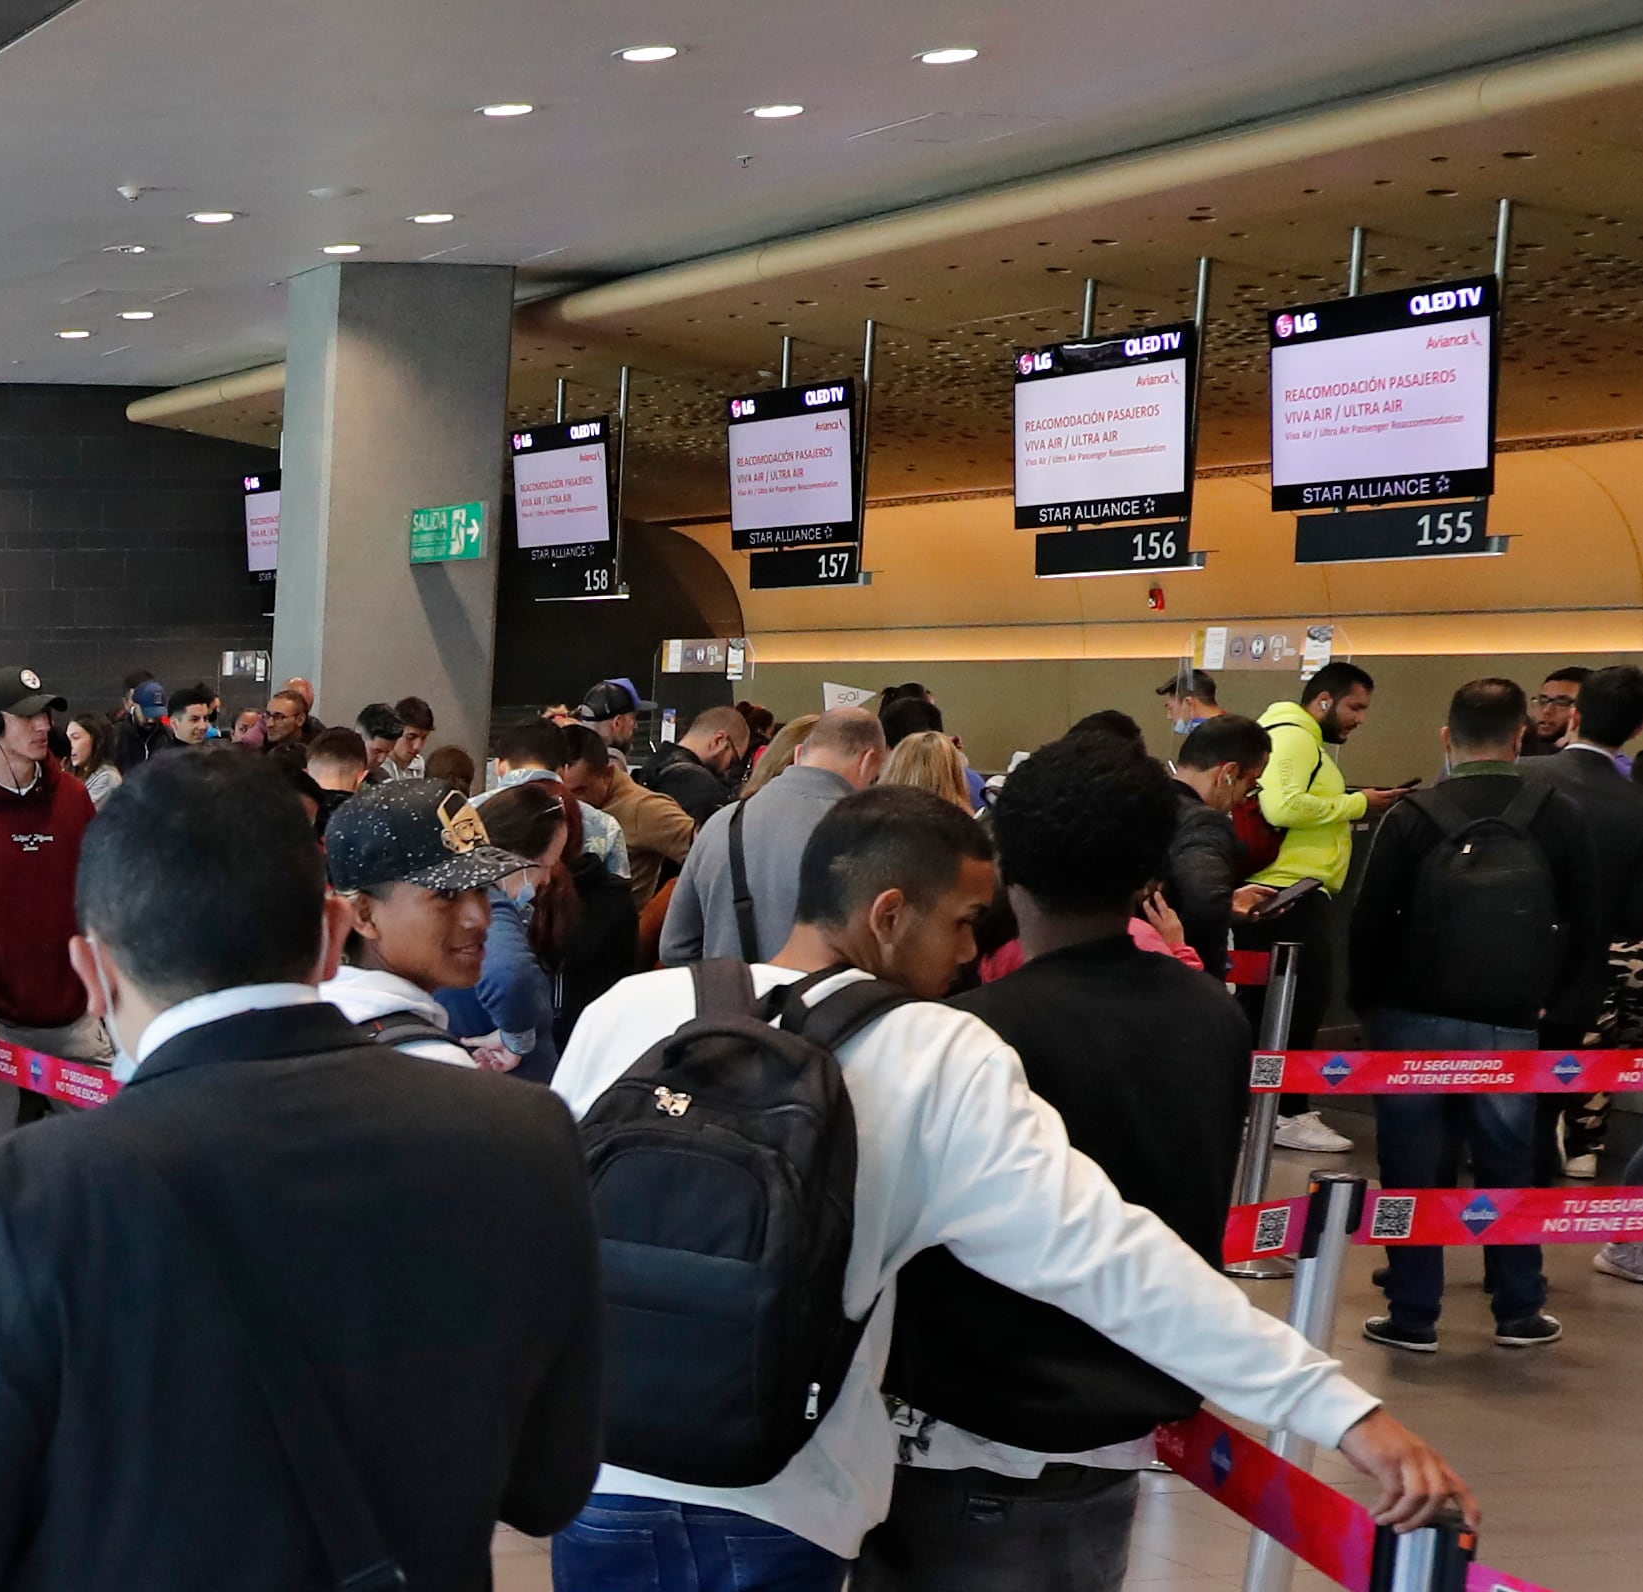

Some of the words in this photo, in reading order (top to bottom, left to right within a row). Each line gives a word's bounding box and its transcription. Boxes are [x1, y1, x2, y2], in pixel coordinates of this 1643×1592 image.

[1410, 292, 1456, 315] OLED
[1455, 286, 1482, 308] TV
[1295, 313, 1317, 334] LG
[1125, 335, 1161, 357] OLED
[1162, 332, 1181, 350] TV
[1426, 332, 1469, 350] Avianca
[1034, 353, 1052, 371] LG
[1136, 373, 1169, 387] Avianca
[1285, 376, 1386, 402] REACOMODACIÓN
[1389, 368, 1457, 389] PASAJEROS
[741, 400, 755, 416] LG
[1025, 409, 1105, 432] REACOMODACIÓN
[1107, 404, 1160, 422] PASAJEROS
[1285, 410, 1312, 424] VIVA
[1314, 408, 1332, 421] AIR
[1344, 403, 1379, 418] ULTRA
[1383, 399, 1403, 414] AIR
[1025, 439, 1045, 452] VIVA
[1048, 437, 1062, 449] AIR
[1072, 432, 1100, 447] ULTRA
[1103, 430, 1118, 443] AIR
[1285, 431, 1301, 441] Viva
[1302, 430, 1312, 439] Air
[1339, 425, 1350, 435] Air
[1352, 421, 1390, 434] Passenger
[1302, 486, 1343, 503] STAR
[1348, 477, 1431, 499] ALLIANCE
[1039, 507, 1071, 522] STAR
[1074, 500, 1140, 520] ALLIANCE
[749, 531, 773, 545] STAR
[775, 526, 822, 542] ALLIANCE
[1417, 511, 1473, 547] 155
[531, 549, 548, 561] STAR
[551, 545, 586, 558] ALLIANCE
[1133, 531, 1177, 561] 156
[818, 553, 849, 579] 157
[585, 569, 608, 591] 158
[1403, 1060, 1422, 1071] TU
[1423, 1059, 1503, 1071] SEGURIDAD
[1387, 1074, 1409, 1085] NO
[1412, 1073, 1452, 1085] TIENE
[1453, 1073, 1514, 1084] ESCALAS
[1618, 1072, 1641, 1082] NO
[1563, 1200, 1587, 1213] TU
[1542, 1219, 1571, 1232] NO
[1574, 1218, 1627, 1231] TIENE
